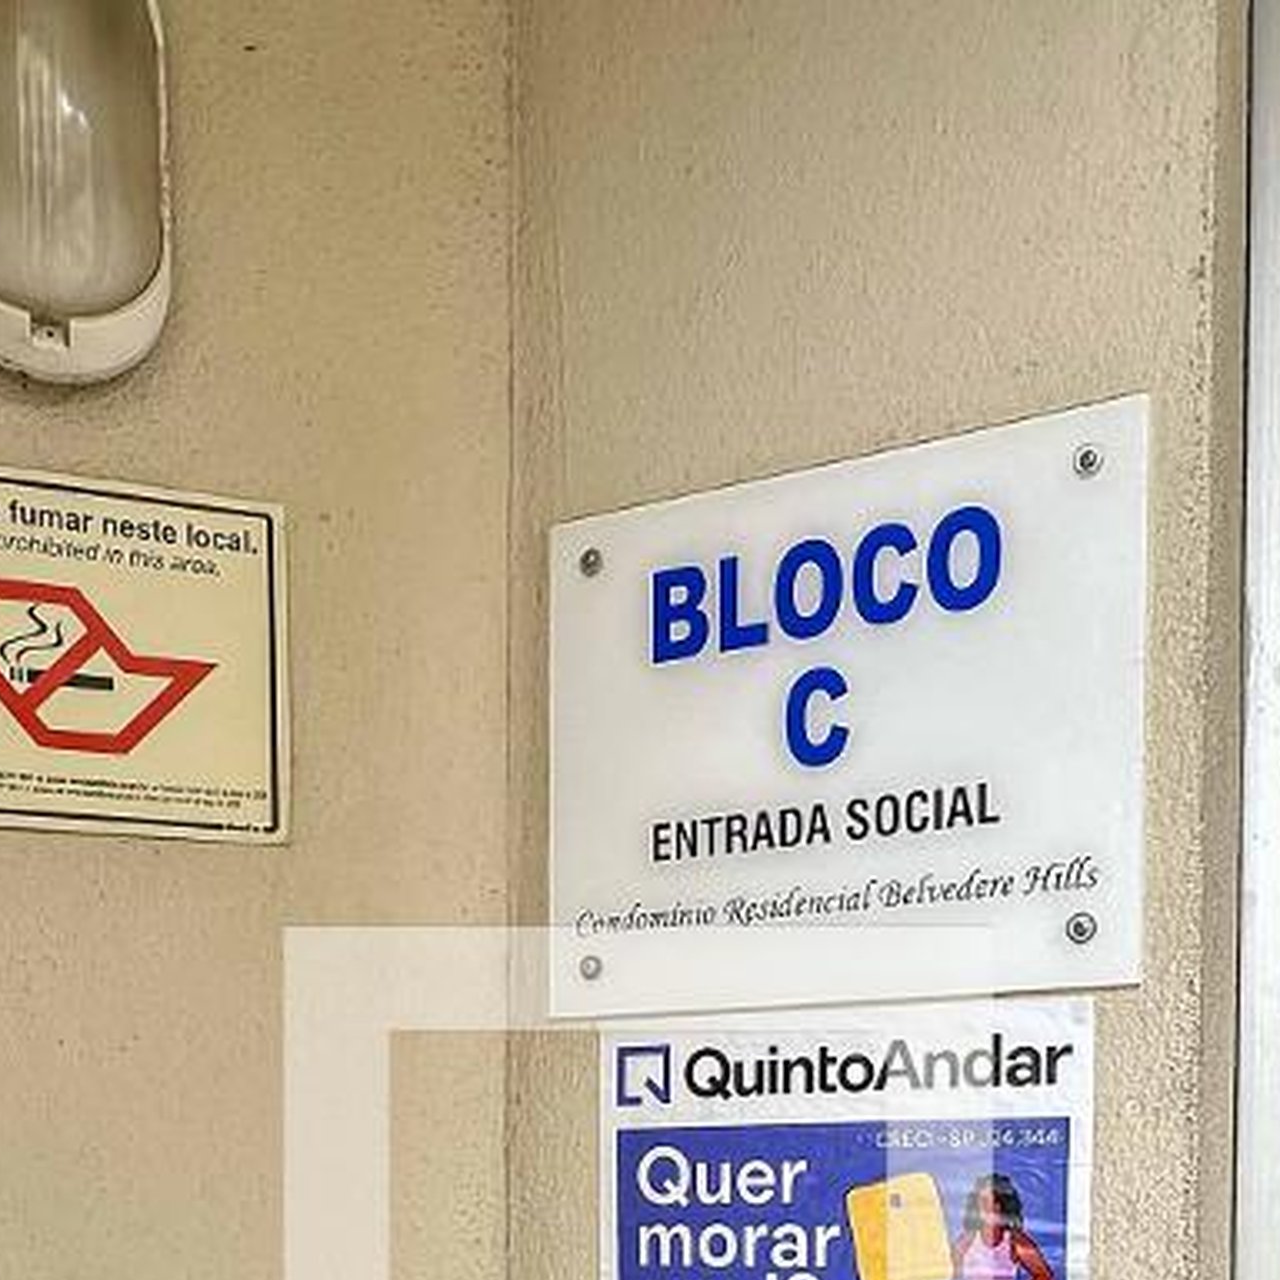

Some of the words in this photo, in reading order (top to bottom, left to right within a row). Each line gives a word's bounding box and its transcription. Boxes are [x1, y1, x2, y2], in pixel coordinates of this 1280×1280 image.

[9, 500, 94, 534] fumar
[102, 518, 178, 545] neste
[186, 523, 258, 555] local.
[104, 545, 124, 564] in
[129, 549, 165, 571] this
[651, 505, 1001, 664] BLOCO
[785, 666, 850, 768] C
[652, 804, 831, 862] ENTRADA
[845, 783, 1000, 842] SOCIAL
[722, 879, 877, 927] Residencial
[878, 868, 1015, 908] Belvedere
[1022, 855, 1101, 896] Hills
[683, 1033, 1074, 1100] QuintoAndar
[637, 1146, 808, 1209] Quer
[638, 1222, 841, 1269] morar
